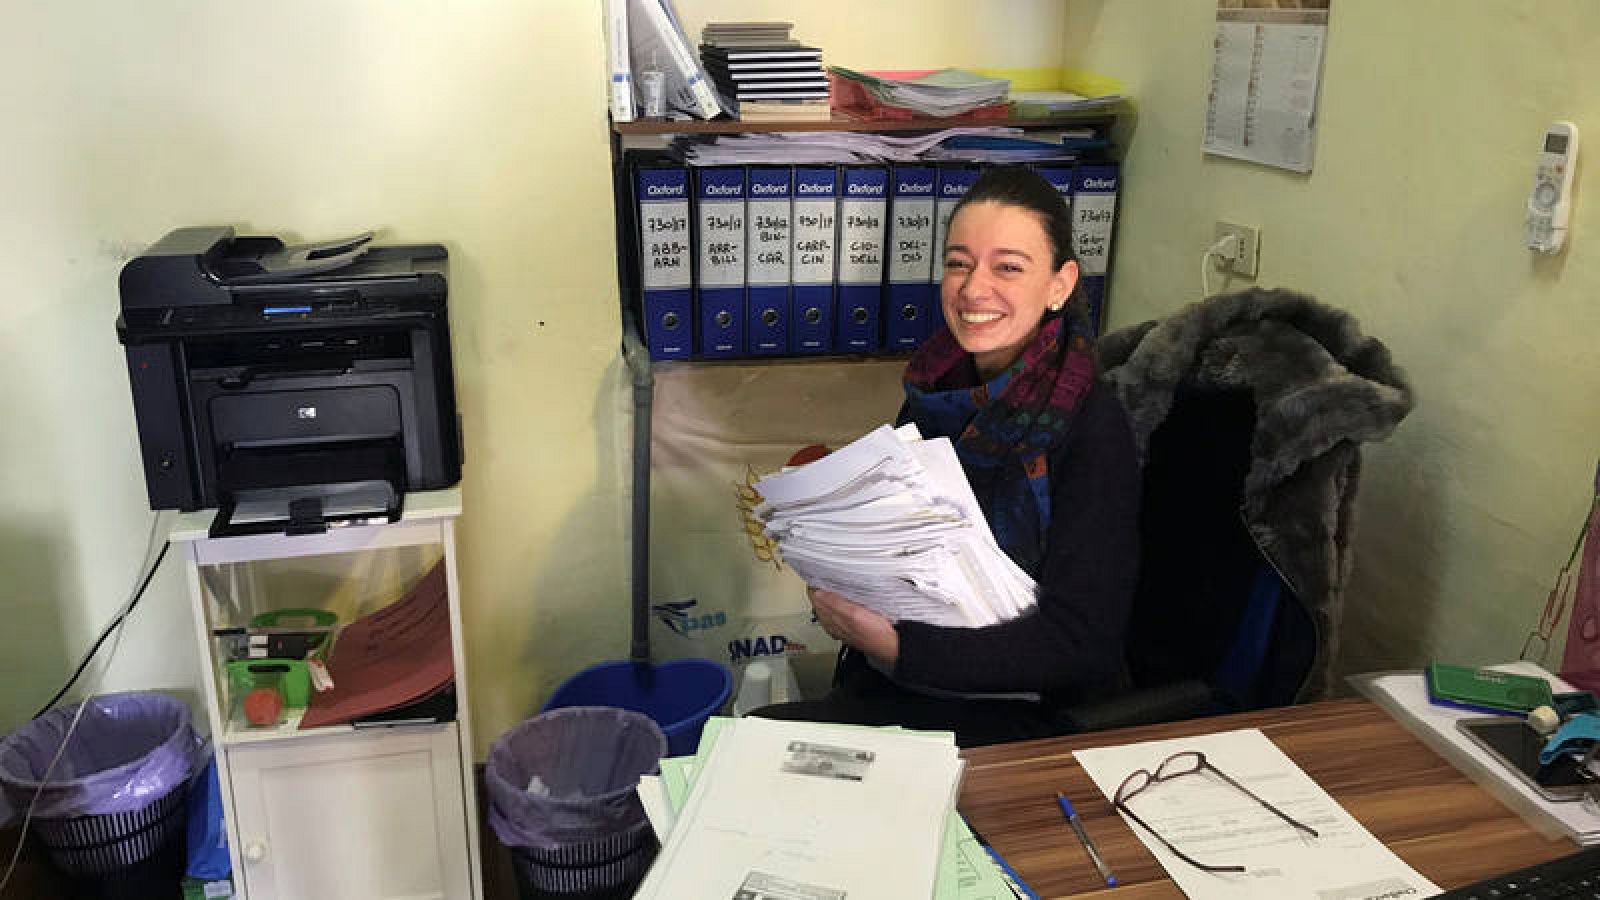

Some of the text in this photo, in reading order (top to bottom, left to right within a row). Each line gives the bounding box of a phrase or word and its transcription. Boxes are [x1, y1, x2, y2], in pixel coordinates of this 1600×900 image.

[647, 183, 684, 195] Oxford
[752, 183, 787, 195] Oxford
[799, 183, 833, 193] Oxford
[847, 184, 883, 194] Oxford
[899, 183, 932, 193] Oxford
[1083, 178, 1116, 189] Oxford
[706, 184, 742, 195] Oxford
